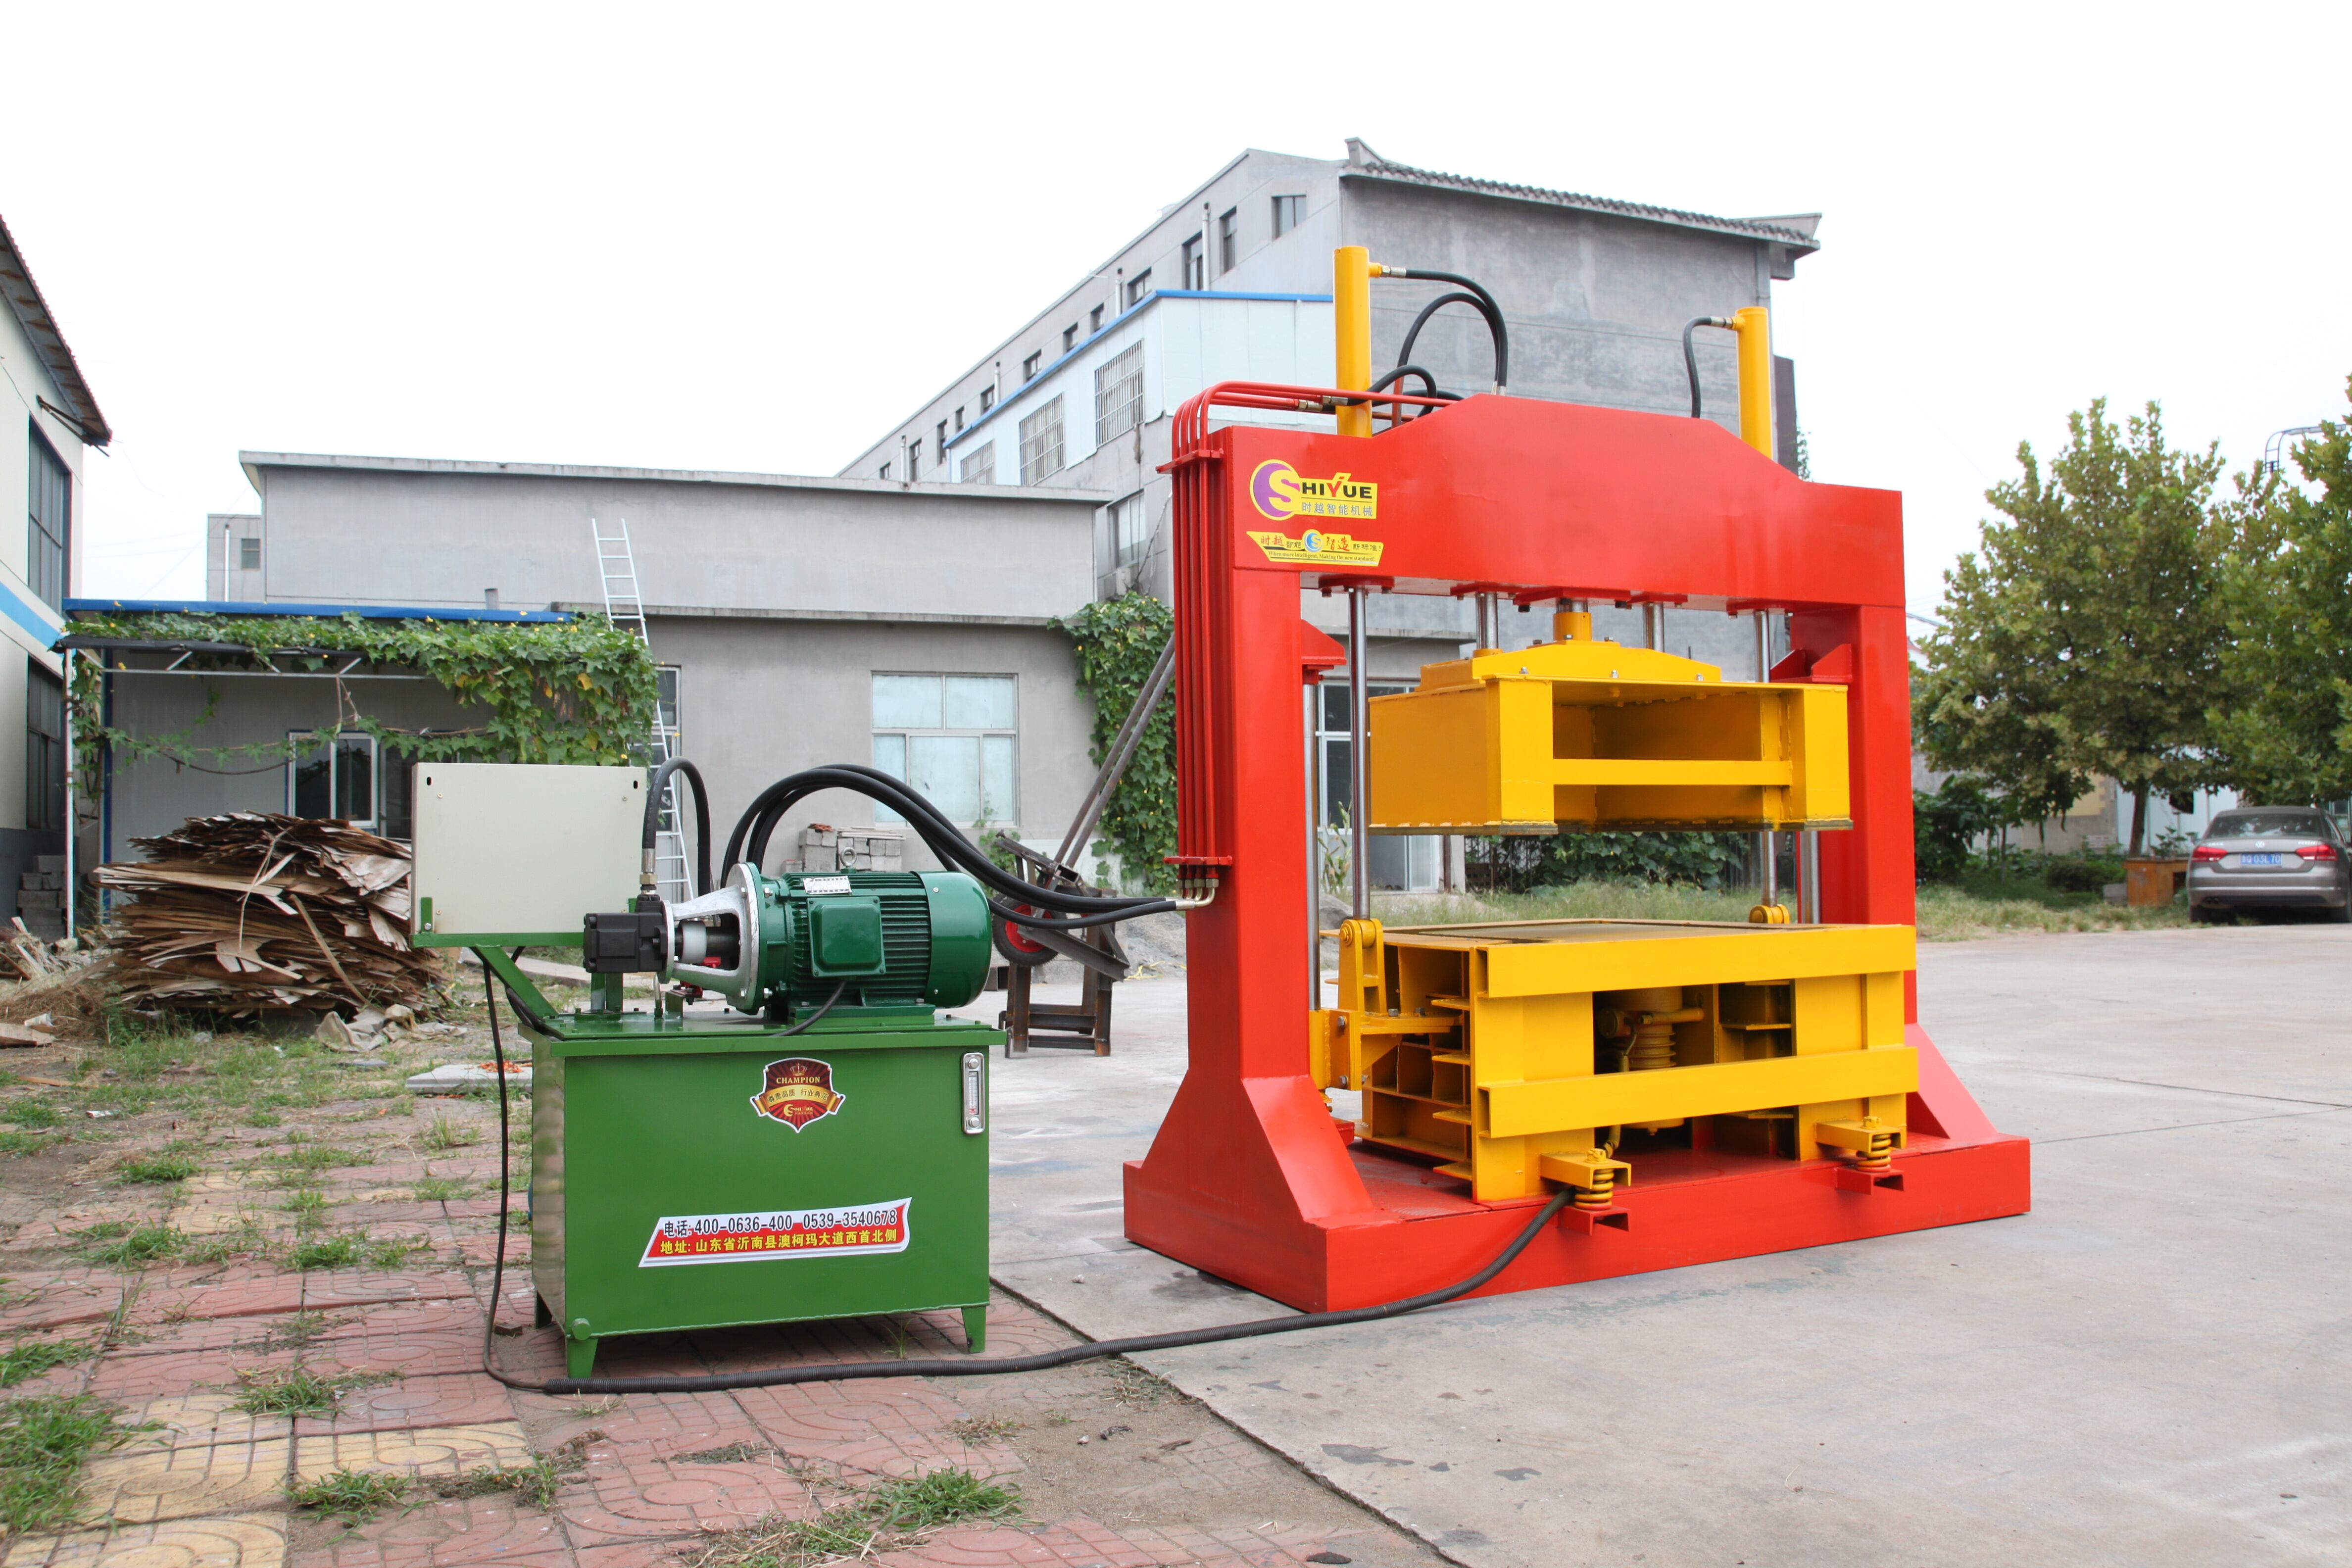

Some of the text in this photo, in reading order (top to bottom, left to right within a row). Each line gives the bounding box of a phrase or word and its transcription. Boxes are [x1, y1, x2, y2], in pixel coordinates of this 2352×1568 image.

[1269, 470, 1372, 512] SHIYUE
[1302, 502, 1373, 517] 时越智能机械
[768, 1088, 829, 1103] 尊贵品质 行业典范
[694, 1215, 792, 1234] 400-0636-400
[803, 1209, 897, 1229] 0539-3540678
[695, 1228, 897, 1252] 山东省沂南县澳柯玛大道西首北侧
